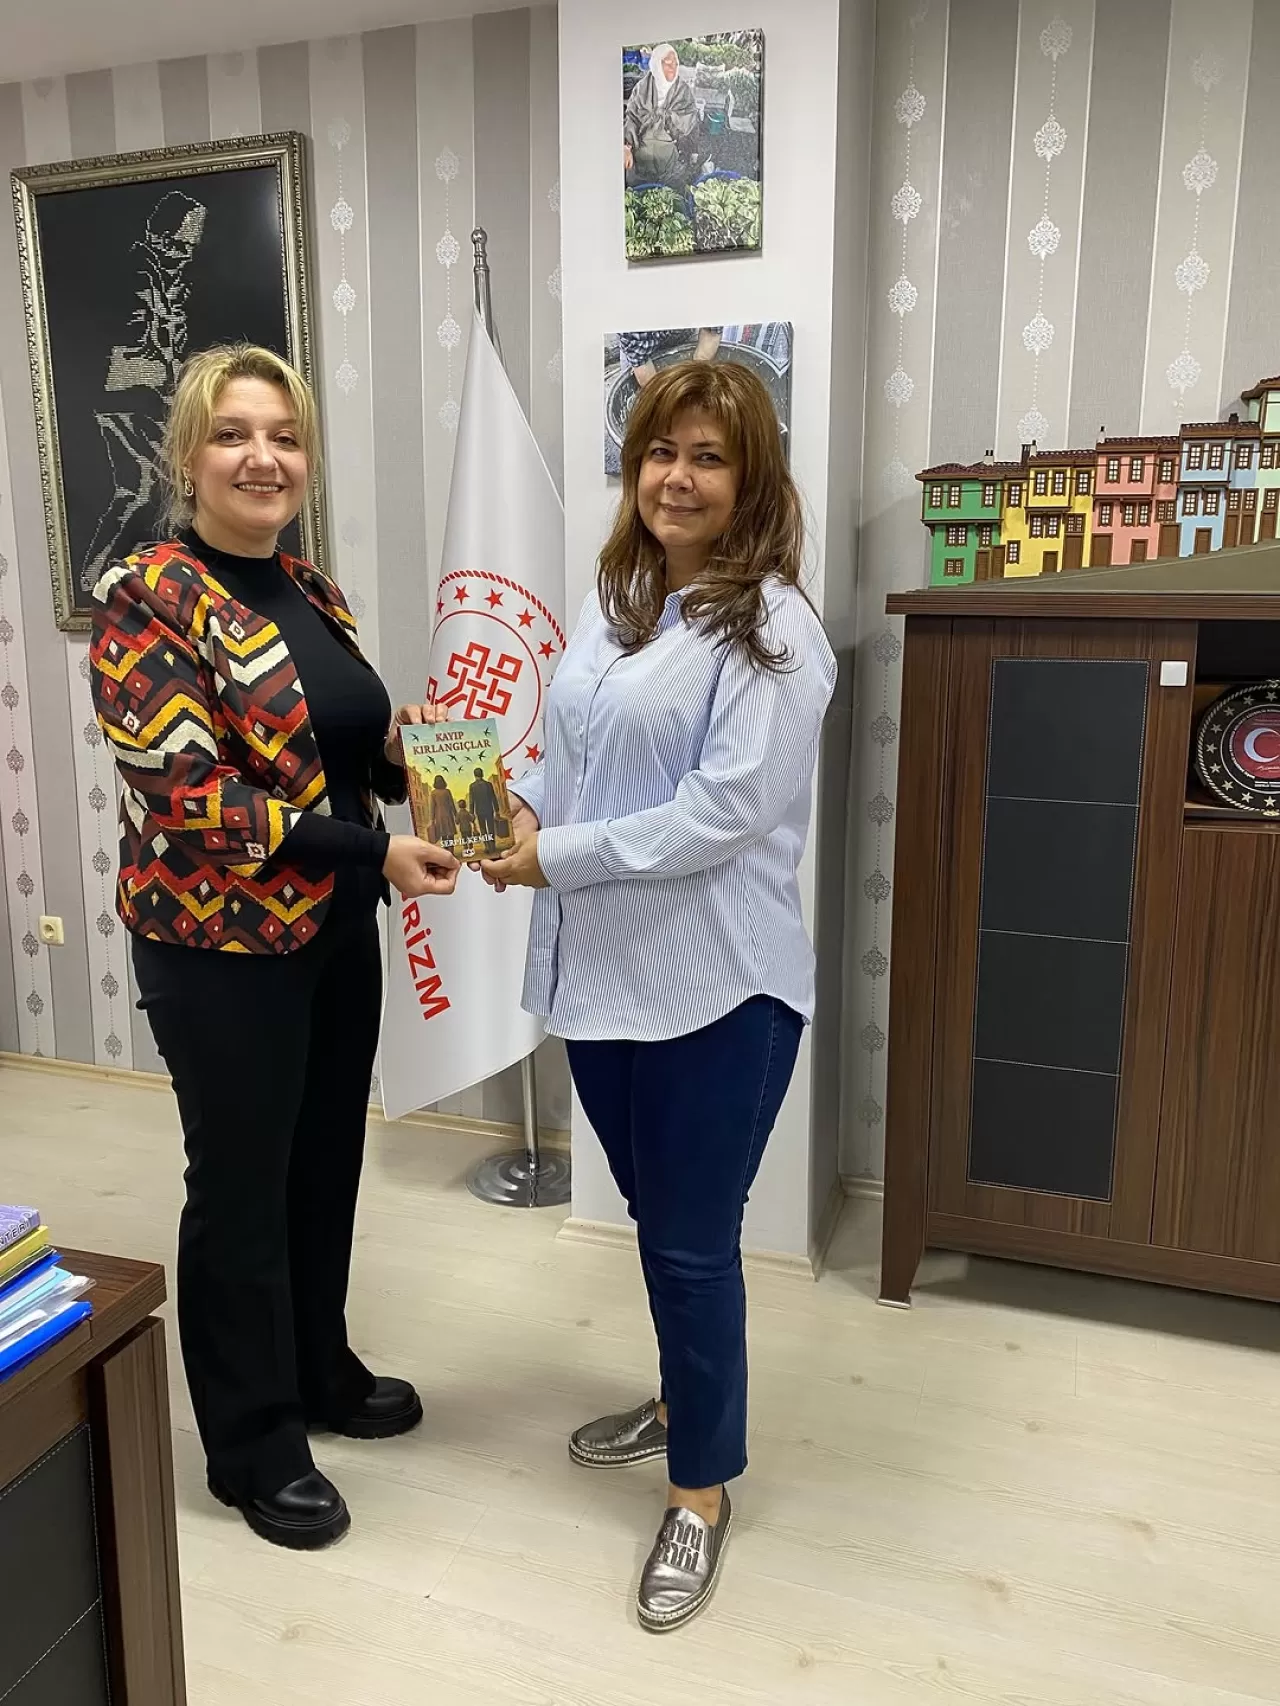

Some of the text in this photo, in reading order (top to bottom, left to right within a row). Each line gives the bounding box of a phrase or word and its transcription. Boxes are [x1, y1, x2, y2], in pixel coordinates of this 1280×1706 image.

[435, 731, 464, 742] KAYIP
[413, 739, 491, 755] KIRLANGIÇLAR
[402, 891, 451, 1021] RİZM
